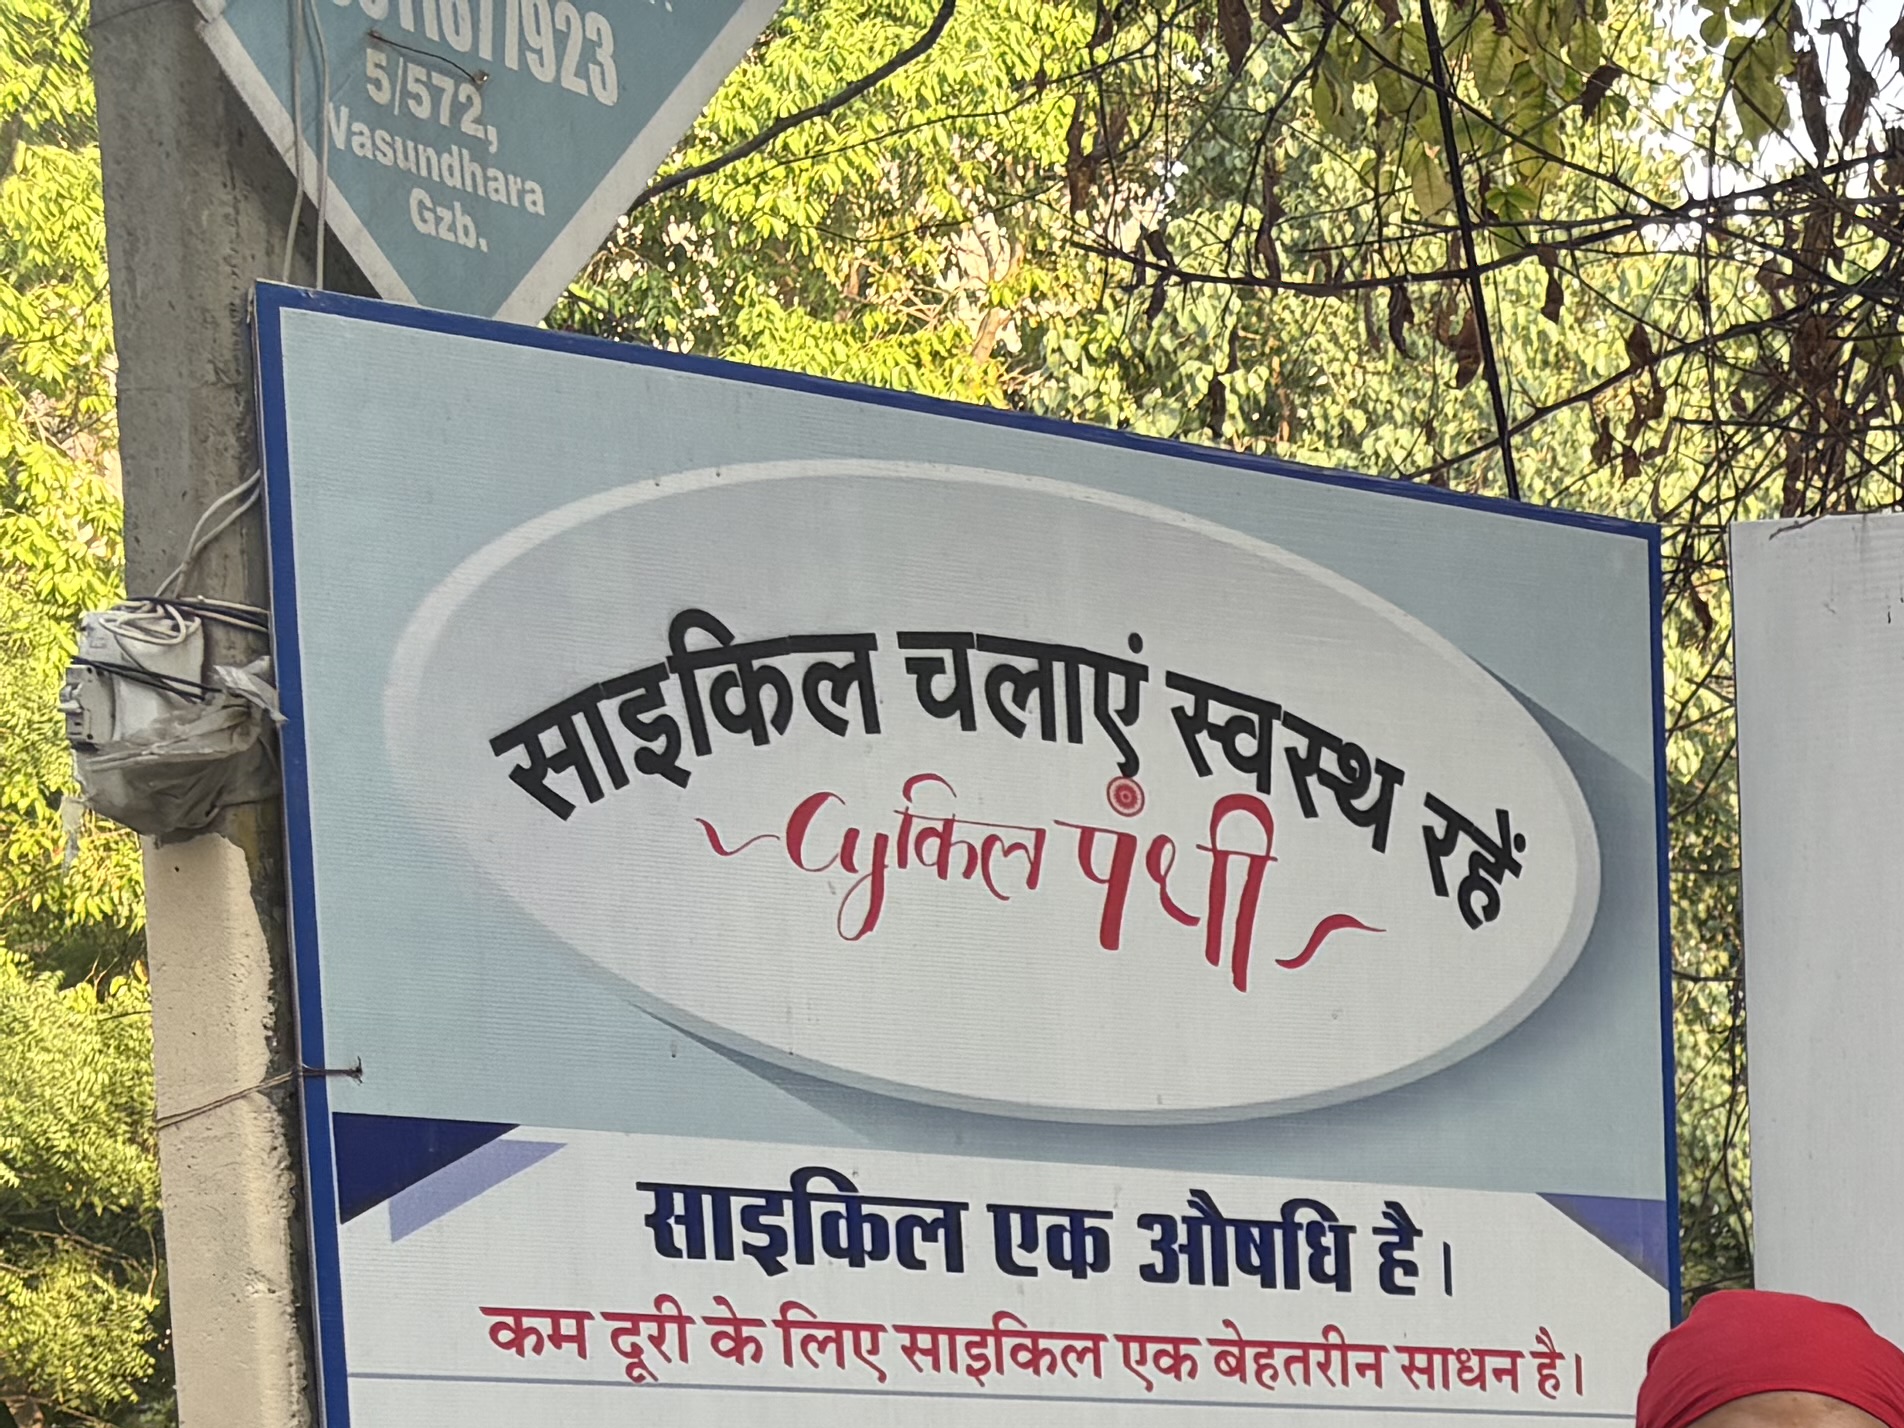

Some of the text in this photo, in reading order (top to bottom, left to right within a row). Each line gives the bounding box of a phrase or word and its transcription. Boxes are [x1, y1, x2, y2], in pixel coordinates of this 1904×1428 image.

[366, 48, 498, 154] 5/572,
[329, 101, 545, 216] Vasundhara
[409, 188, 488, 252] Gzb.
[489, 607, 1522, 929] साइकिल चलाएं स्वस्थ रहें
[637, 1167, 967, 1278] साइकिल
[989, 1197, 1113, 1279] एक
[1138, 1189, 1357, 1293] औषधि
[481, 1305, 588, 1358] कम
[602, 1293, 691, 1385] दूरी
[709, 1295, 767, 1365] के
[773, 1302, 888, 1386] लिए
[898, 1311, 1108, 1381] साइकिल
[1119, 1334, 1201, 1392] एक
[1210, 1318, 1387, 1390] बेहतरीन
[1398, 1344, 1521, 1396] साधन
